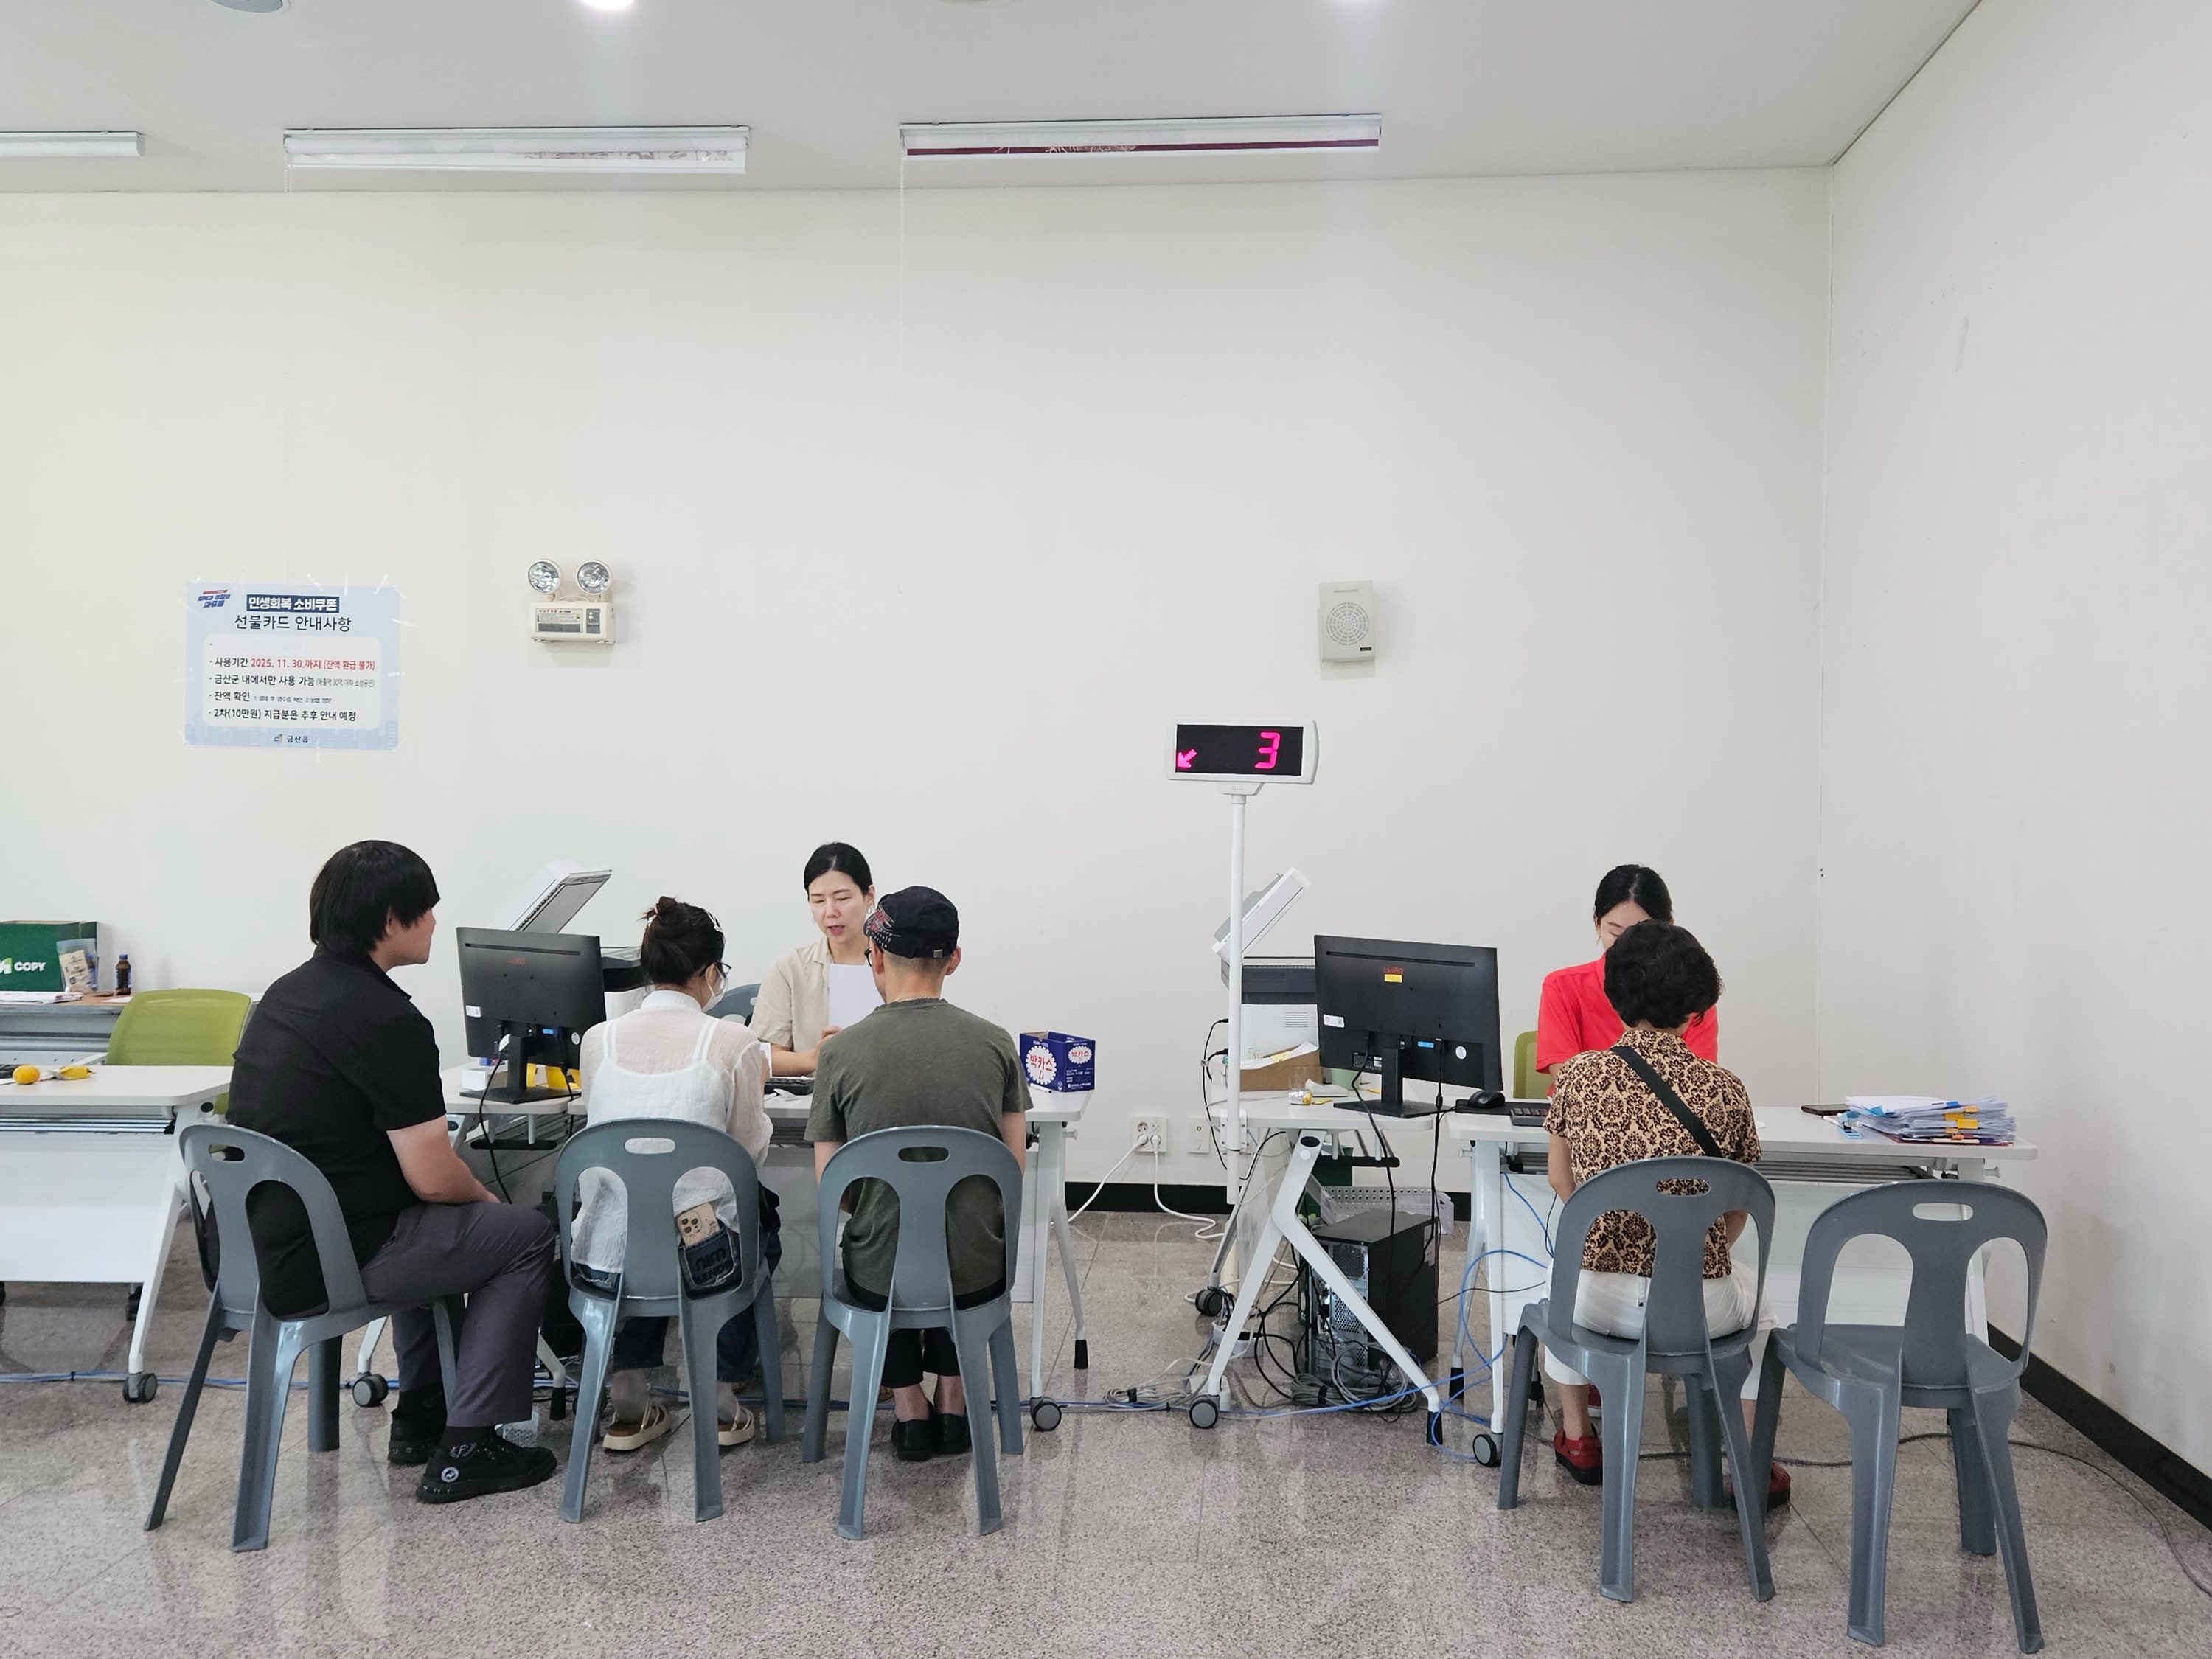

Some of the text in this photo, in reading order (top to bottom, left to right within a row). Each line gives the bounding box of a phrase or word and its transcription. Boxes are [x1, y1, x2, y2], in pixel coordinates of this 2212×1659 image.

[248, 597, 338, 611] 민생회복 소비쿠폰
[234, 615, 352, 632] 선불카드 안내사항
[215, 657, 249, 668] 사용기간
[251, 658, 274, 668] 2025.
[277, 659, 290, 668] 11.
[324, 660, 341, 670] (잔액
[342, 661, 357, 670] 환급
[358, 661, 375, 671] 불가)
[215, 674, 240, 685] 금산군
[242, 675, 276, 686] 내에서만
[279, 676, 296, 686] 사용
[299, 676, 316, 687] 가능
[215, 692, 232, 702] 잔액
[234, 692, 250, 702] 확인
[214, 709, 356, 722] 2차(10만원) 지급분은 추후 안내 예정
[287, 735, 308, 744] 금산읍
[1254, 731, 1281, 770] 3
[14, 961, 46, 972] COPY
[1030, 1054, 1053, 1071] 박카스
[1039, 1071, 1044, 1080] D
